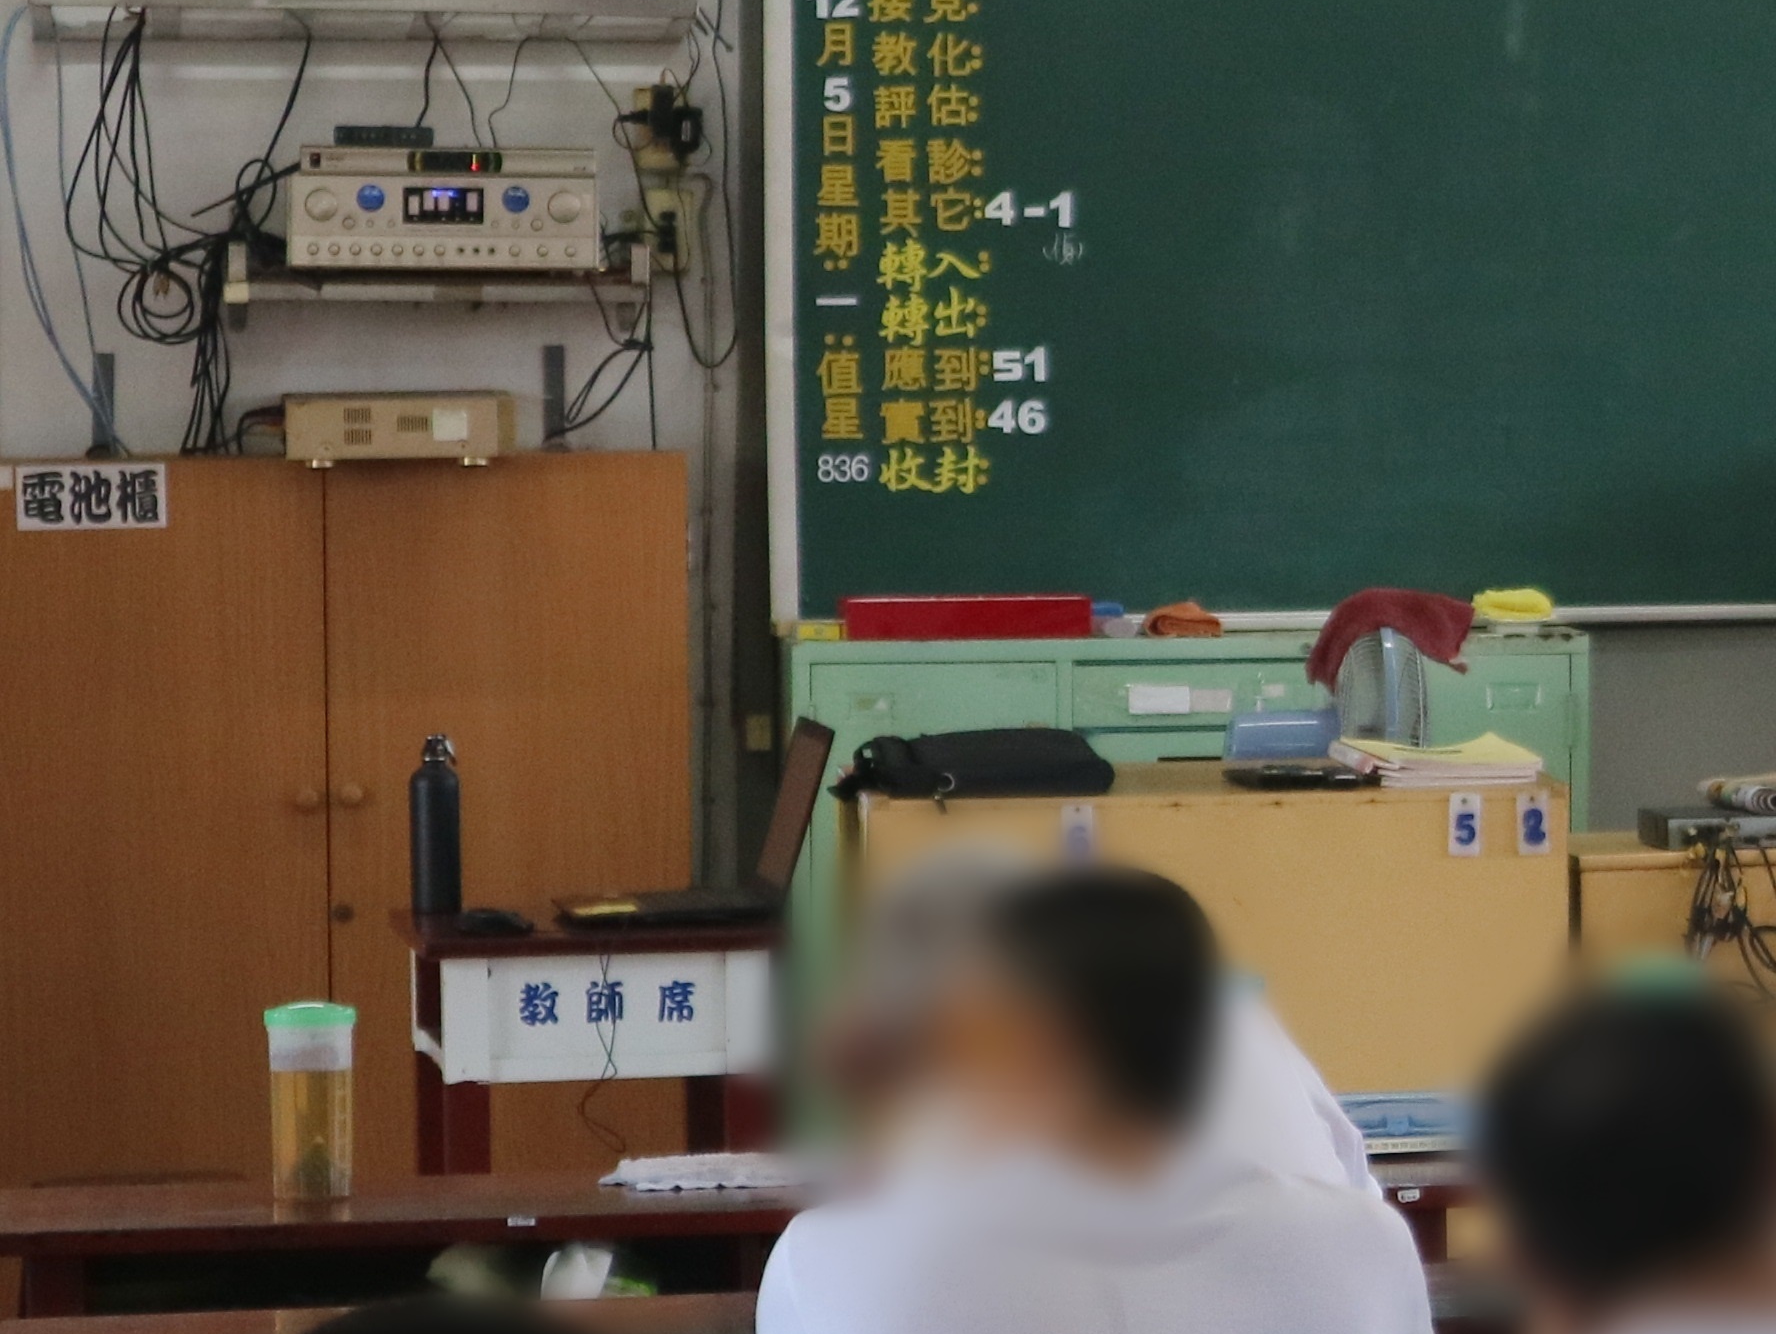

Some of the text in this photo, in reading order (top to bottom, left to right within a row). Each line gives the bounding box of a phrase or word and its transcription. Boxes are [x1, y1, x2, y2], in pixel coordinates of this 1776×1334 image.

[22, 470, 160, 525] 電池櫃
[1455, 813, 1476, 846] 5
[519, 980, 696, 1026] 教師席
